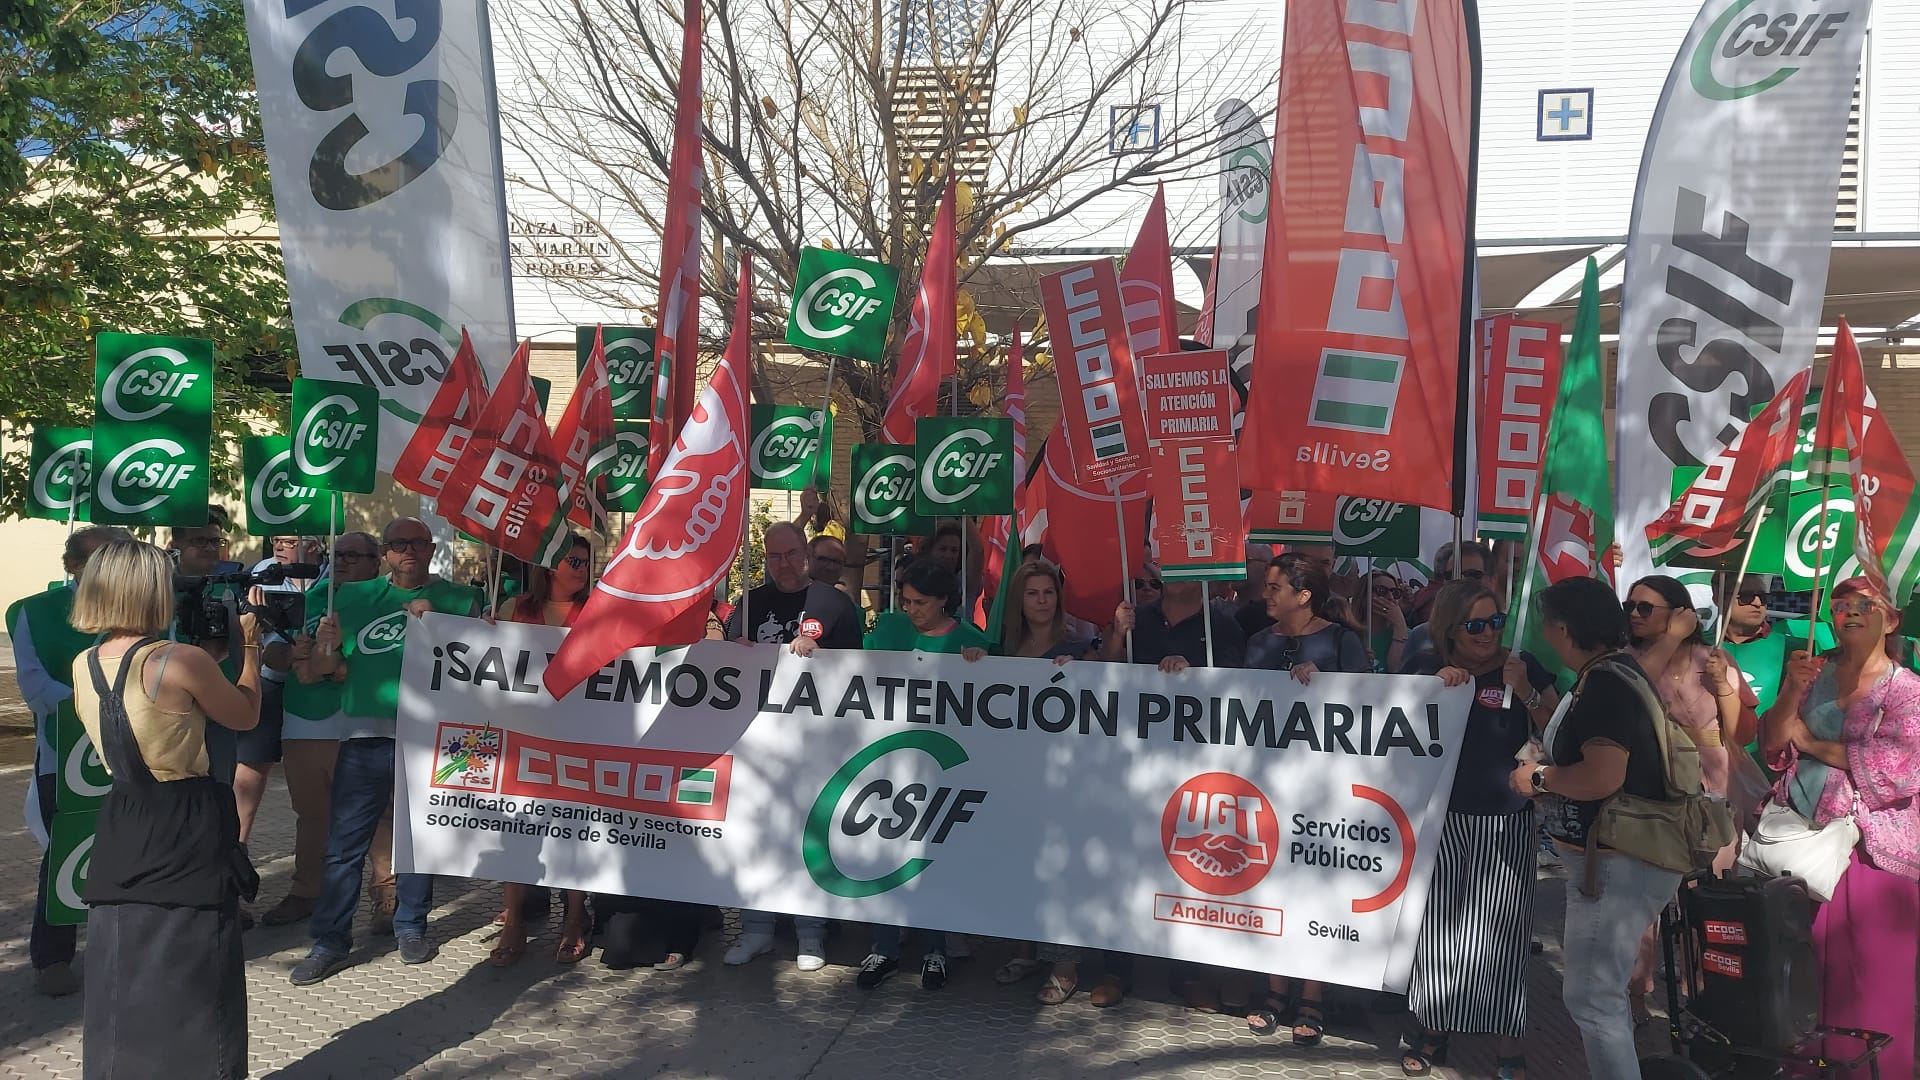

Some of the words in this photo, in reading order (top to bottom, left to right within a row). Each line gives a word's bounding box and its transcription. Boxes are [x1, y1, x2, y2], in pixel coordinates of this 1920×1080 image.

[1721, 12, 1850, 58] CSIF
[510, 221, 558, 234] LAZA
[536, 242, 609, 255] MARTIN
[813, 287, 882, 322] CSIF
[1648, 186, 1794, 466] CSIF
[1060, 266, 1121, 423] CCOO
[122, 369, 199, 398] CSIF
[1146, 370, 1209, 390] SALVEMOS
[1212, 368, 1228, 385] LA
[1160, 390, 1216, 412] ATENCIÓN
[1160, 415, 1219, 434] PRIMARIA
[1495, 325, 1548, 510] CCOO
[308, 419, 367, 450] CSIF
[763, 434, 818, 459] CSIF
[937, 451, 1002, 478] CSIF
[1092, 462, 1136, 476] Sociosanitarios
[1115, 454, 1140, 464] Sectores
[117, 461, 196, 489] CSIF
[869, 477, 916, 501] CSI
[1178, 446, 1213, 558] CCOO
[1343, 497, 1408, 523] CSIF
[369, 623, 407, 640] CSI
[430, 641, 743, 711] ¡SALEMOS
[758, 669, 823, 716] LA
[835, 671, 1120, 737] ATENCIÓN
[1137, 692, 1444, 758] PRIMARIA!
[460, 771, 491, 786] fss
[517, 747, 674, 802] CCOO
[429, 792, 517, 814] sindicato
[523, 799, 545, 817] de
[551, 804, 624, 826] sanidad
[628, 814, 638, 830] y
[644, 817, 723, 839] sectores
[840, 779, 988, 844] CSIF
[1176, 791, 1263, 844] UGT
[426, 811, 572, 840] sociosanitarios
[578, 824, 600, 843] de
[606, 828, 666, 850] Sevilla
[1291, 813, 1391, 844] Servicios
[1290, 841, 1383, 873] Públicos
[1171, 901, 1264, 929] Andalucía
[1707, 924, 1735, 934] CCOO
[1308, 921, 1360, 943] Sevilla
[1704, 952, 1731, 966] CCOO
